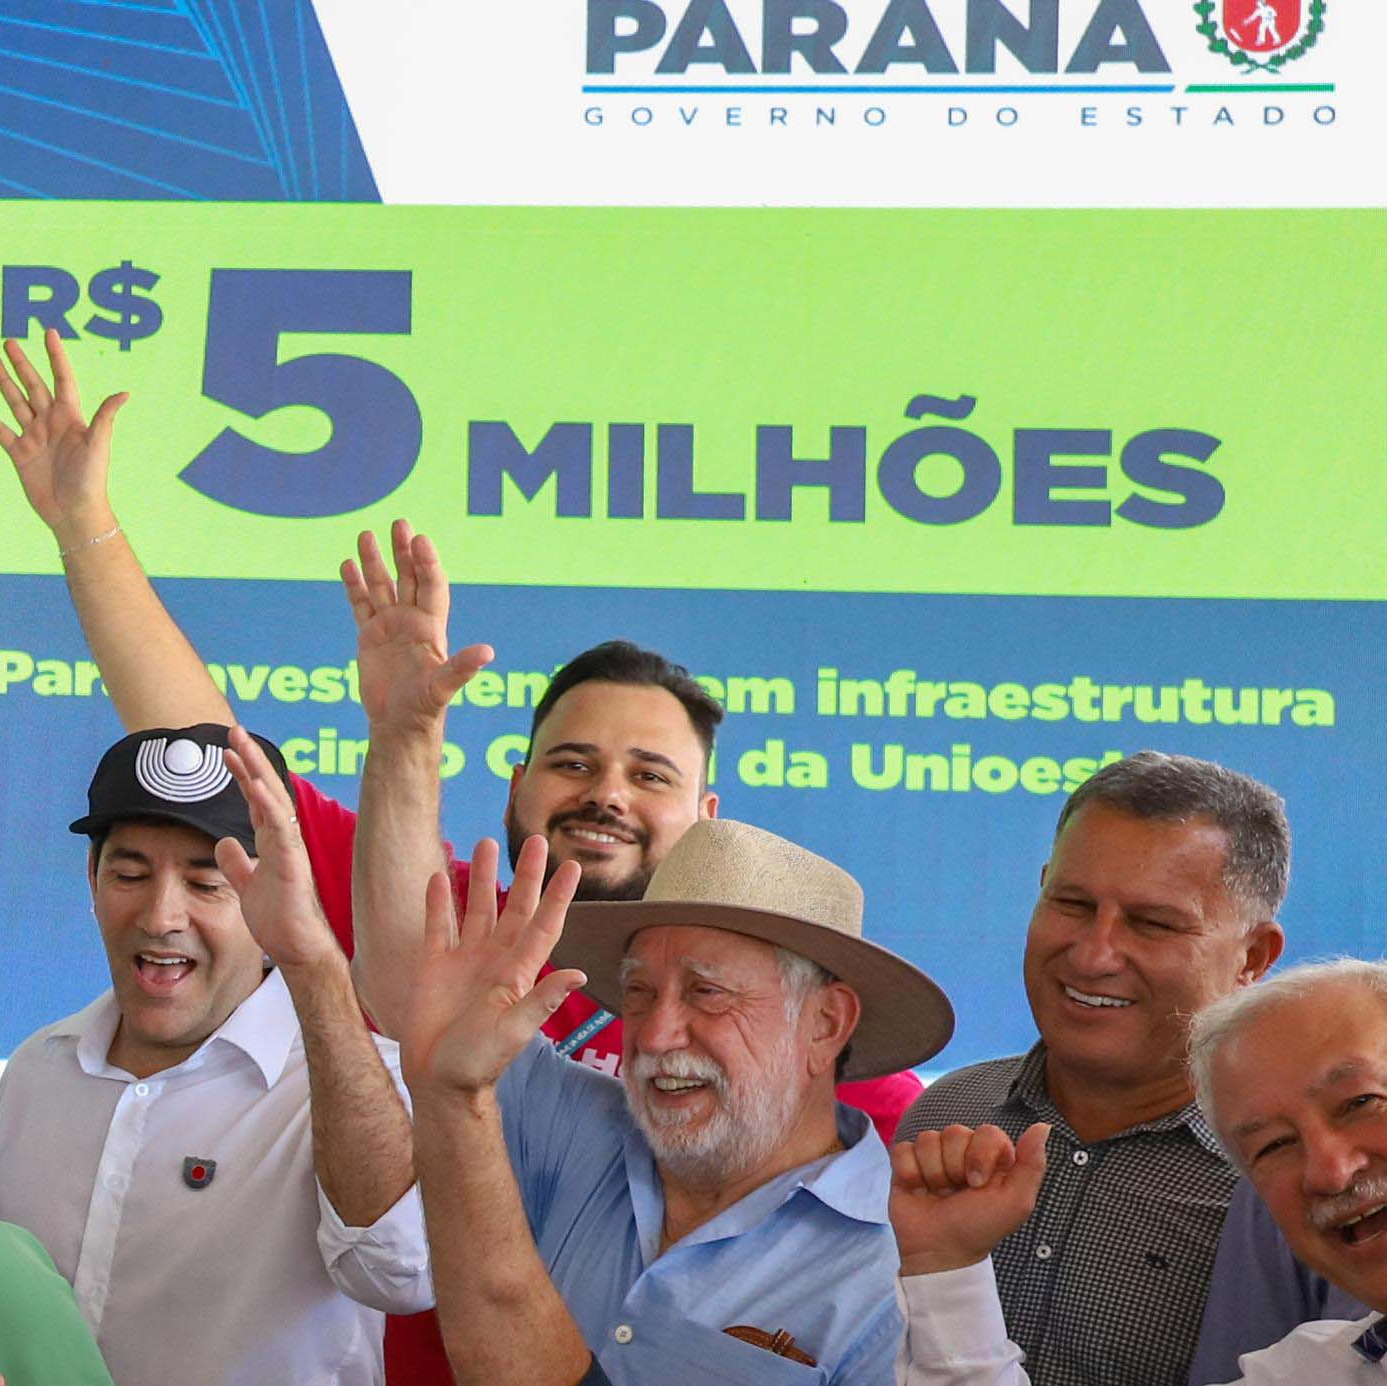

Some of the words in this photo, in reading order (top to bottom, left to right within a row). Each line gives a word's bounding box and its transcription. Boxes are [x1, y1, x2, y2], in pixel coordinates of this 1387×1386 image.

[584, 106, 887, 127] GOVERNO
[948, 106, 1020, 127] DO
[1080, 105, 1337, 127] ESTADO
[1, 260, 164, 352] R$
[177, 267, 424, 520] 5
[467, 393, 1227, 531] MILHÕES
[817, 667, 1336, 727] infraestrutura
[279, 728, 466, 781] cino
[737, 738, 828, 788] da
